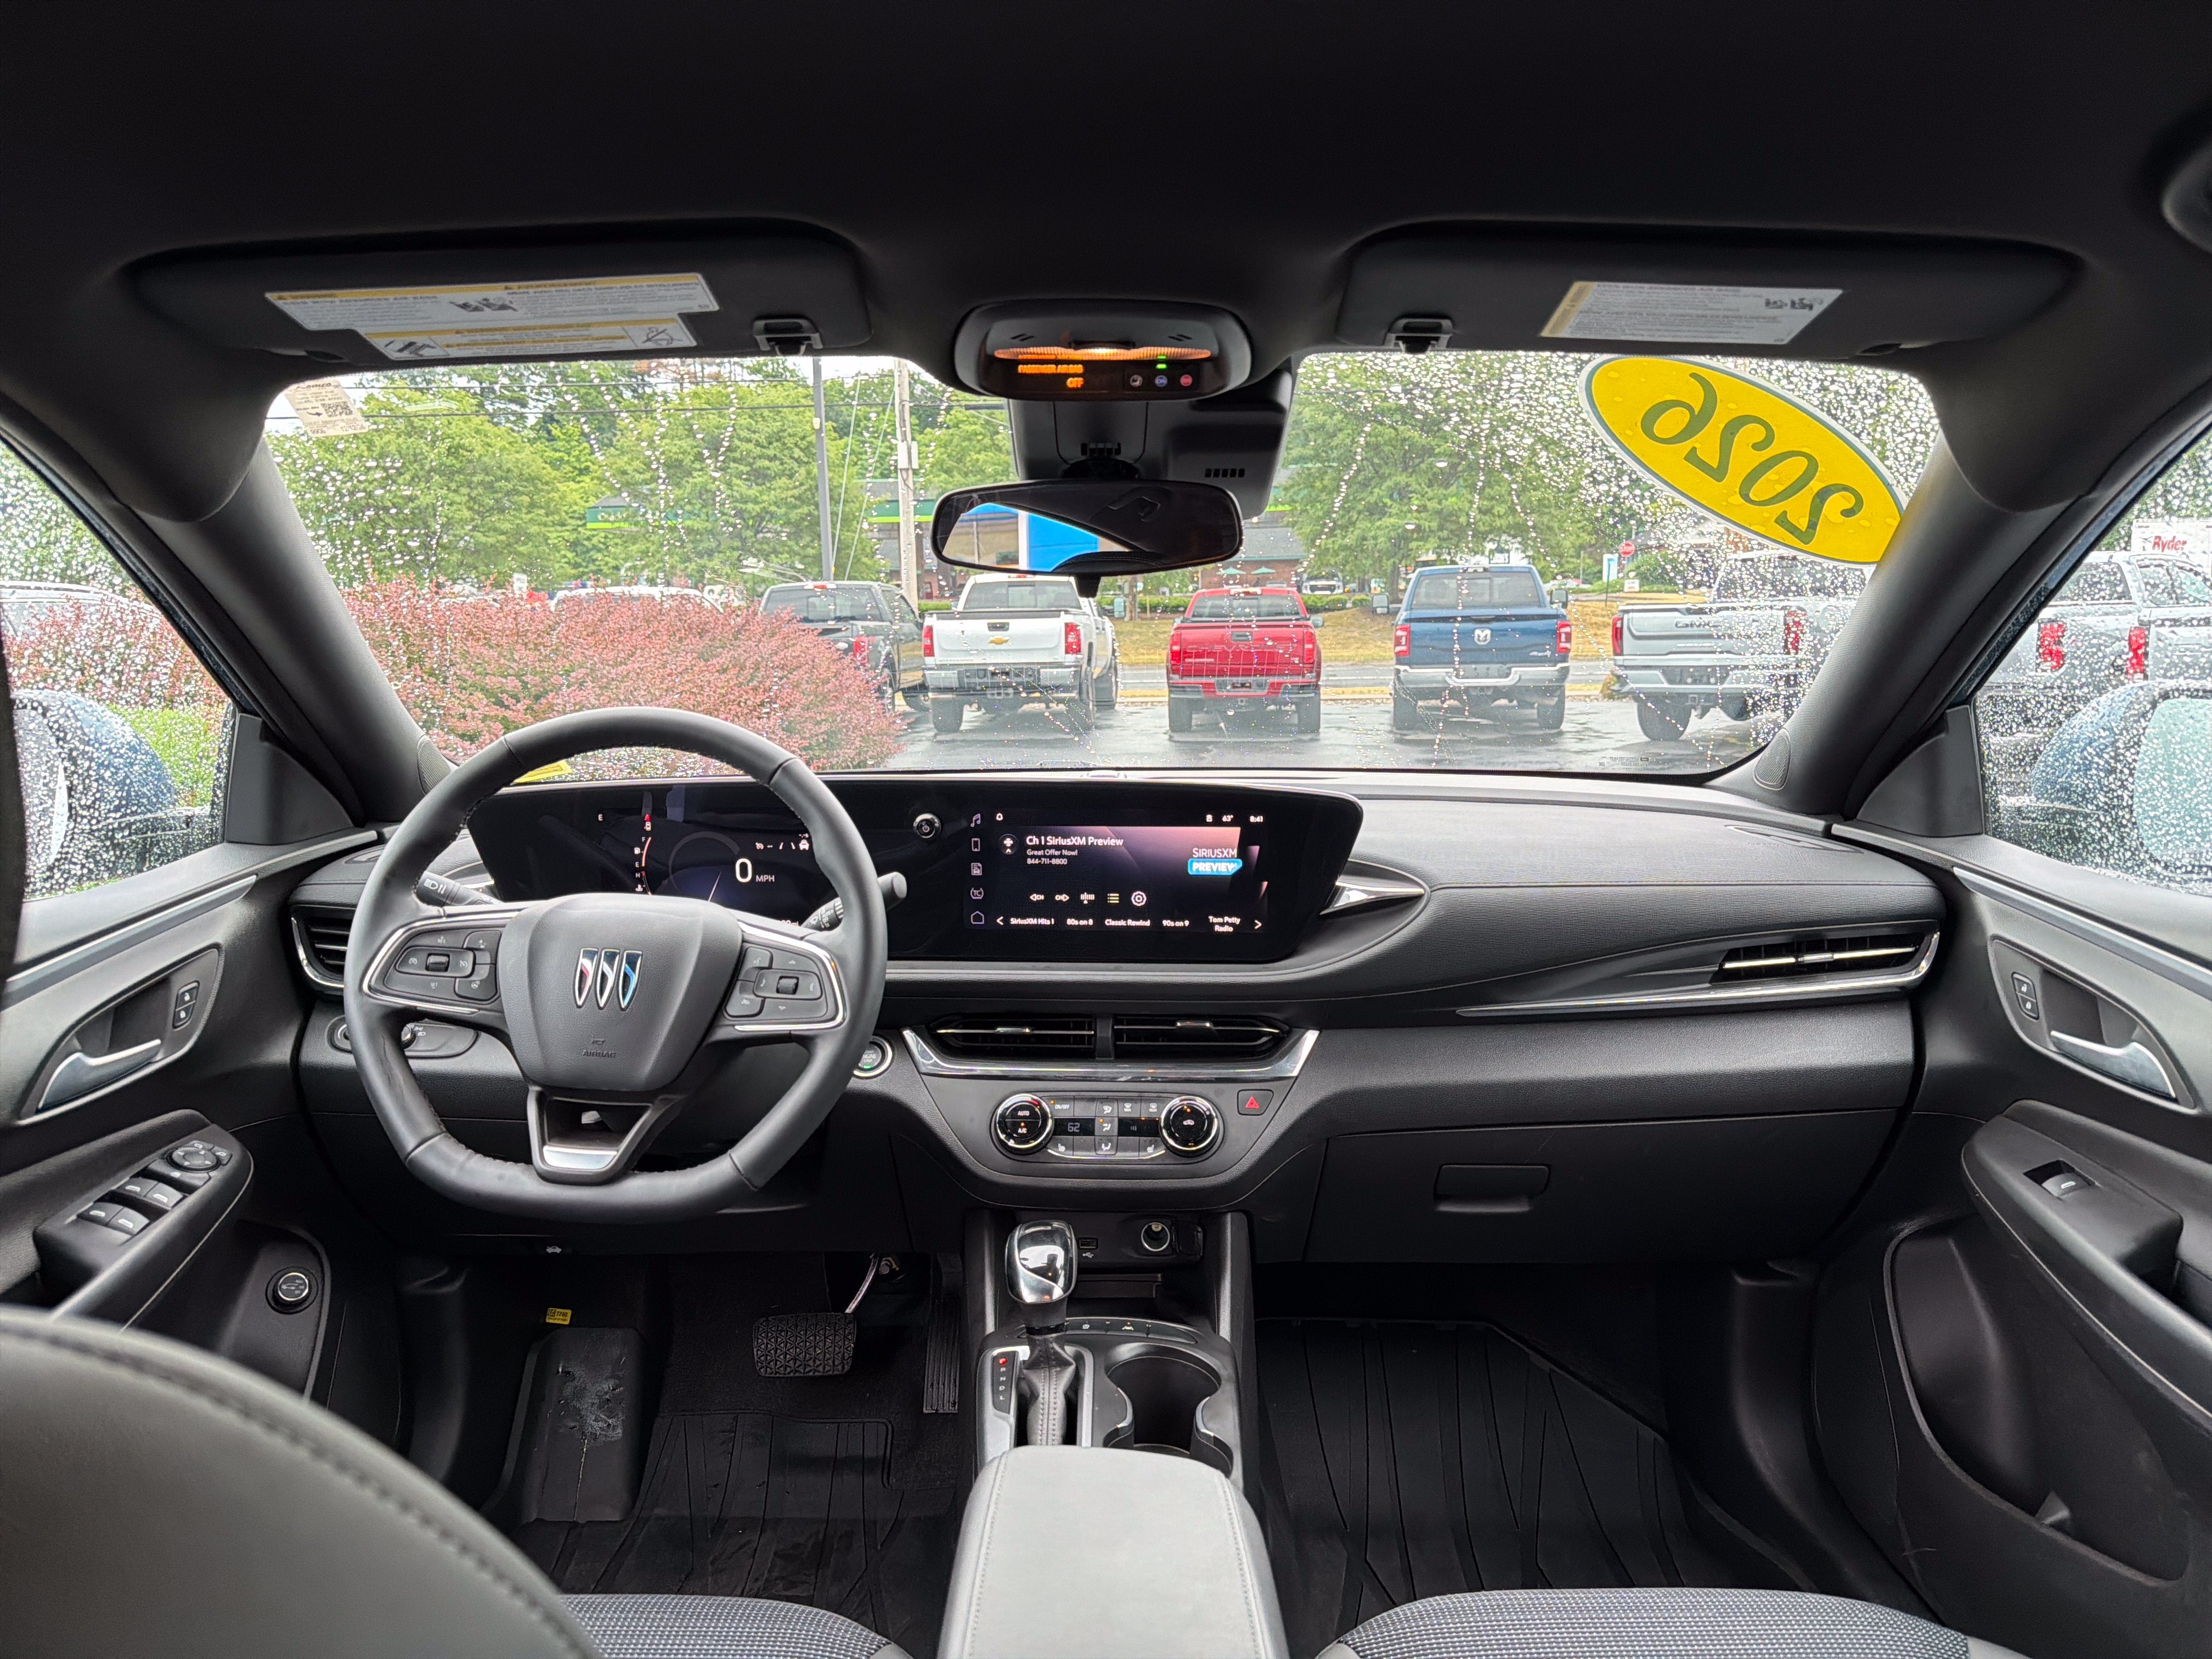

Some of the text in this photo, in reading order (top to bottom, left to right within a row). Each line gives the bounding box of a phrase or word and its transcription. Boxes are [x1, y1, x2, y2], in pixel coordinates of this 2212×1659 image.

[2152, 535, 2187, 553] Ryder
[1675, 618, 1721, 629] GMC
[1026, 836, 1124, 846] Ch 1 SiriusXM Preview
[1192, 848, 1238, 858] SIRIUSXM
[735, 858, 752, 883] 0
[1192, 862, 1238, 872] PREVIEW
[1224, 917, 1240, 925] Petty
[1068, 1122, 1080, 1132] 62
